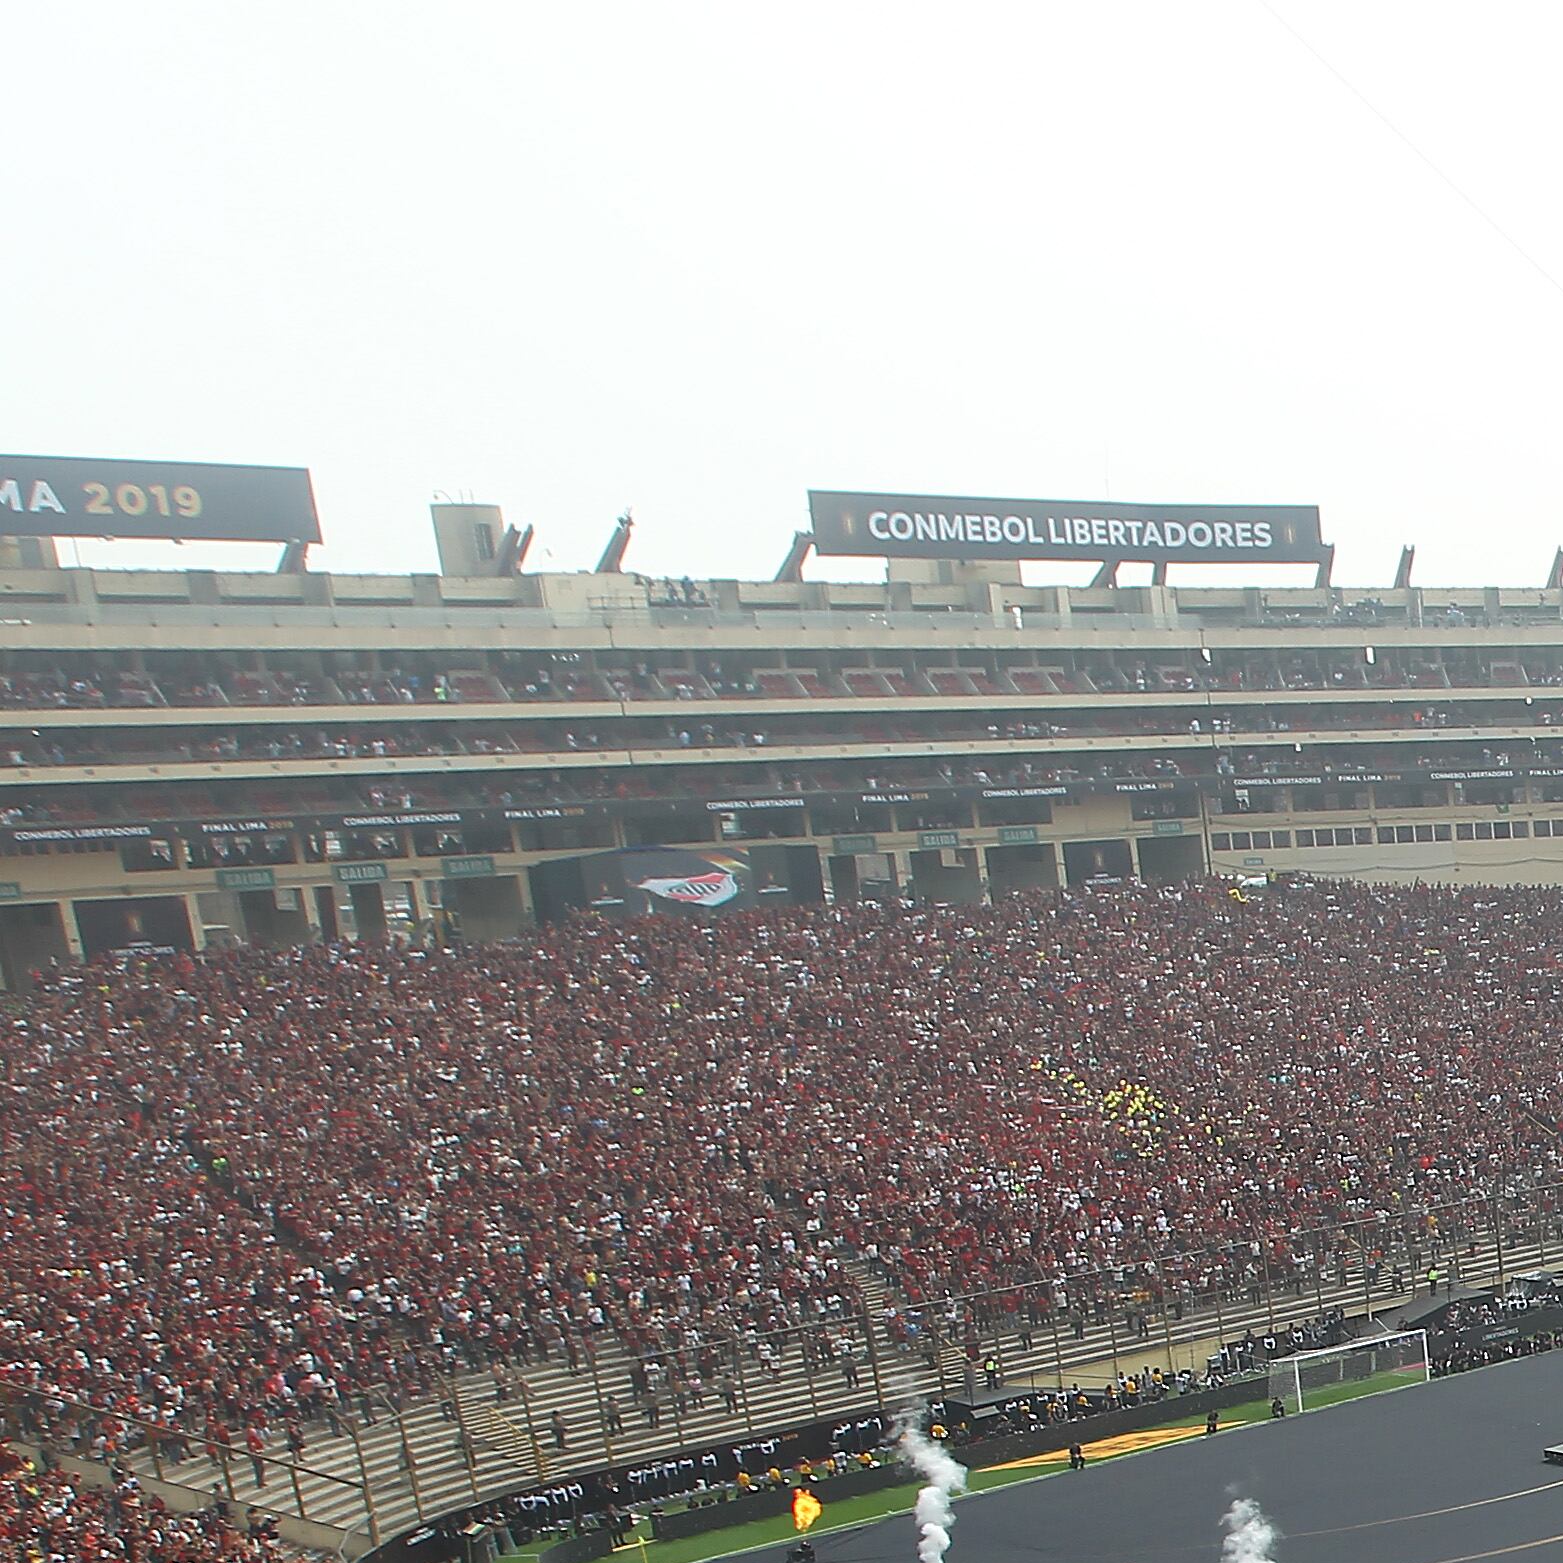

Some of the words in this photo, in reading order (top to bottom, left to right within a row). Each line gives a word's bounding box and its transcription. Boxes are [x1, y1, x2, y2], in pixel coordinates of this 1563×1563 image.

[0, 479, 66, 514] MA
[84, 481, 203, 517] 2019
[869, 511, 1044, 545] CONMEBOL
[1048, 517, 1272, 548] LIBERTADORES
[1430, 771, 1470, 780] CONMEBOL
[1470, 769, 1514, 779] LIBERTADORES
[1233, 777, 1275, 787] CONMEBOL
[1276, 775, 1322, 785] LIBERTADORES
[862, 794, 888, 803] FINAL
[889, 793, 910, 802] LIMA
[982, 789, 1020, 798] CONMEBOL
[1021, 787, 1068, 796] LIBERTADORES
[706, 801, 750, 812] CONMEBOL
[750, 798, 804, 809] LIBERTADORES
[343, 816, 397, 828] CONMEBOL
[397, 812, 460, 824] LIBERTADORES
[504, 810, 535, 820] FINAL
[536, 809, 561, 818] LIMA
[202, 823, 238, 833] FINAL
[239, 821, 267, 831] LIMA
[14, 830, 74, 841] CONMEBOL
[74, 826, 151, 839] LIBERTADORES
[922, 834, 958, 846] SALIDA
[338, 864, 384, 880] SALIDA
